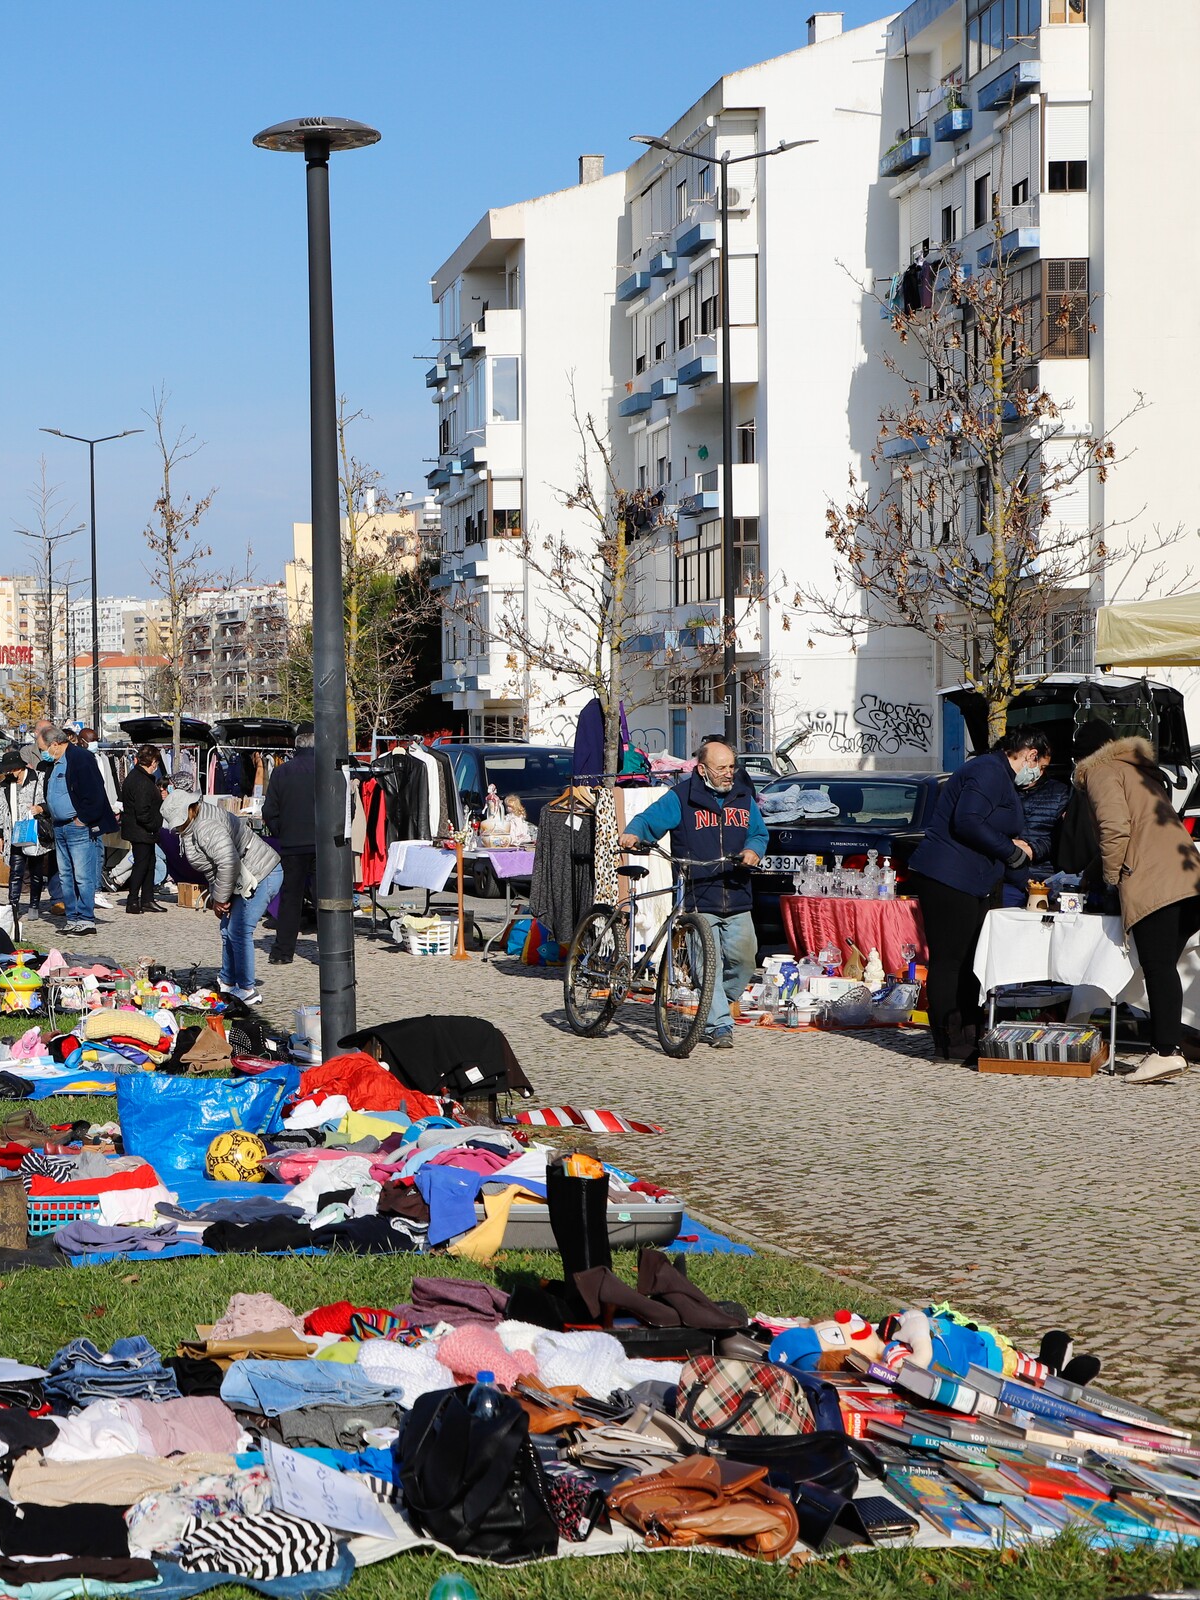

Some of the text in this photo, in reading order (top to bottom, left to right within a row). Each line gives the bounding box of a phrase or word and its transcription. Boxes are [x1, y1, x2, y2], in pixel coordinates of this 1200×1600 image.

[694, 807, 750, 830] NIKE
[970, 1433, 985, 1442] 100
[966, 1445, 988, 1455] SONH
